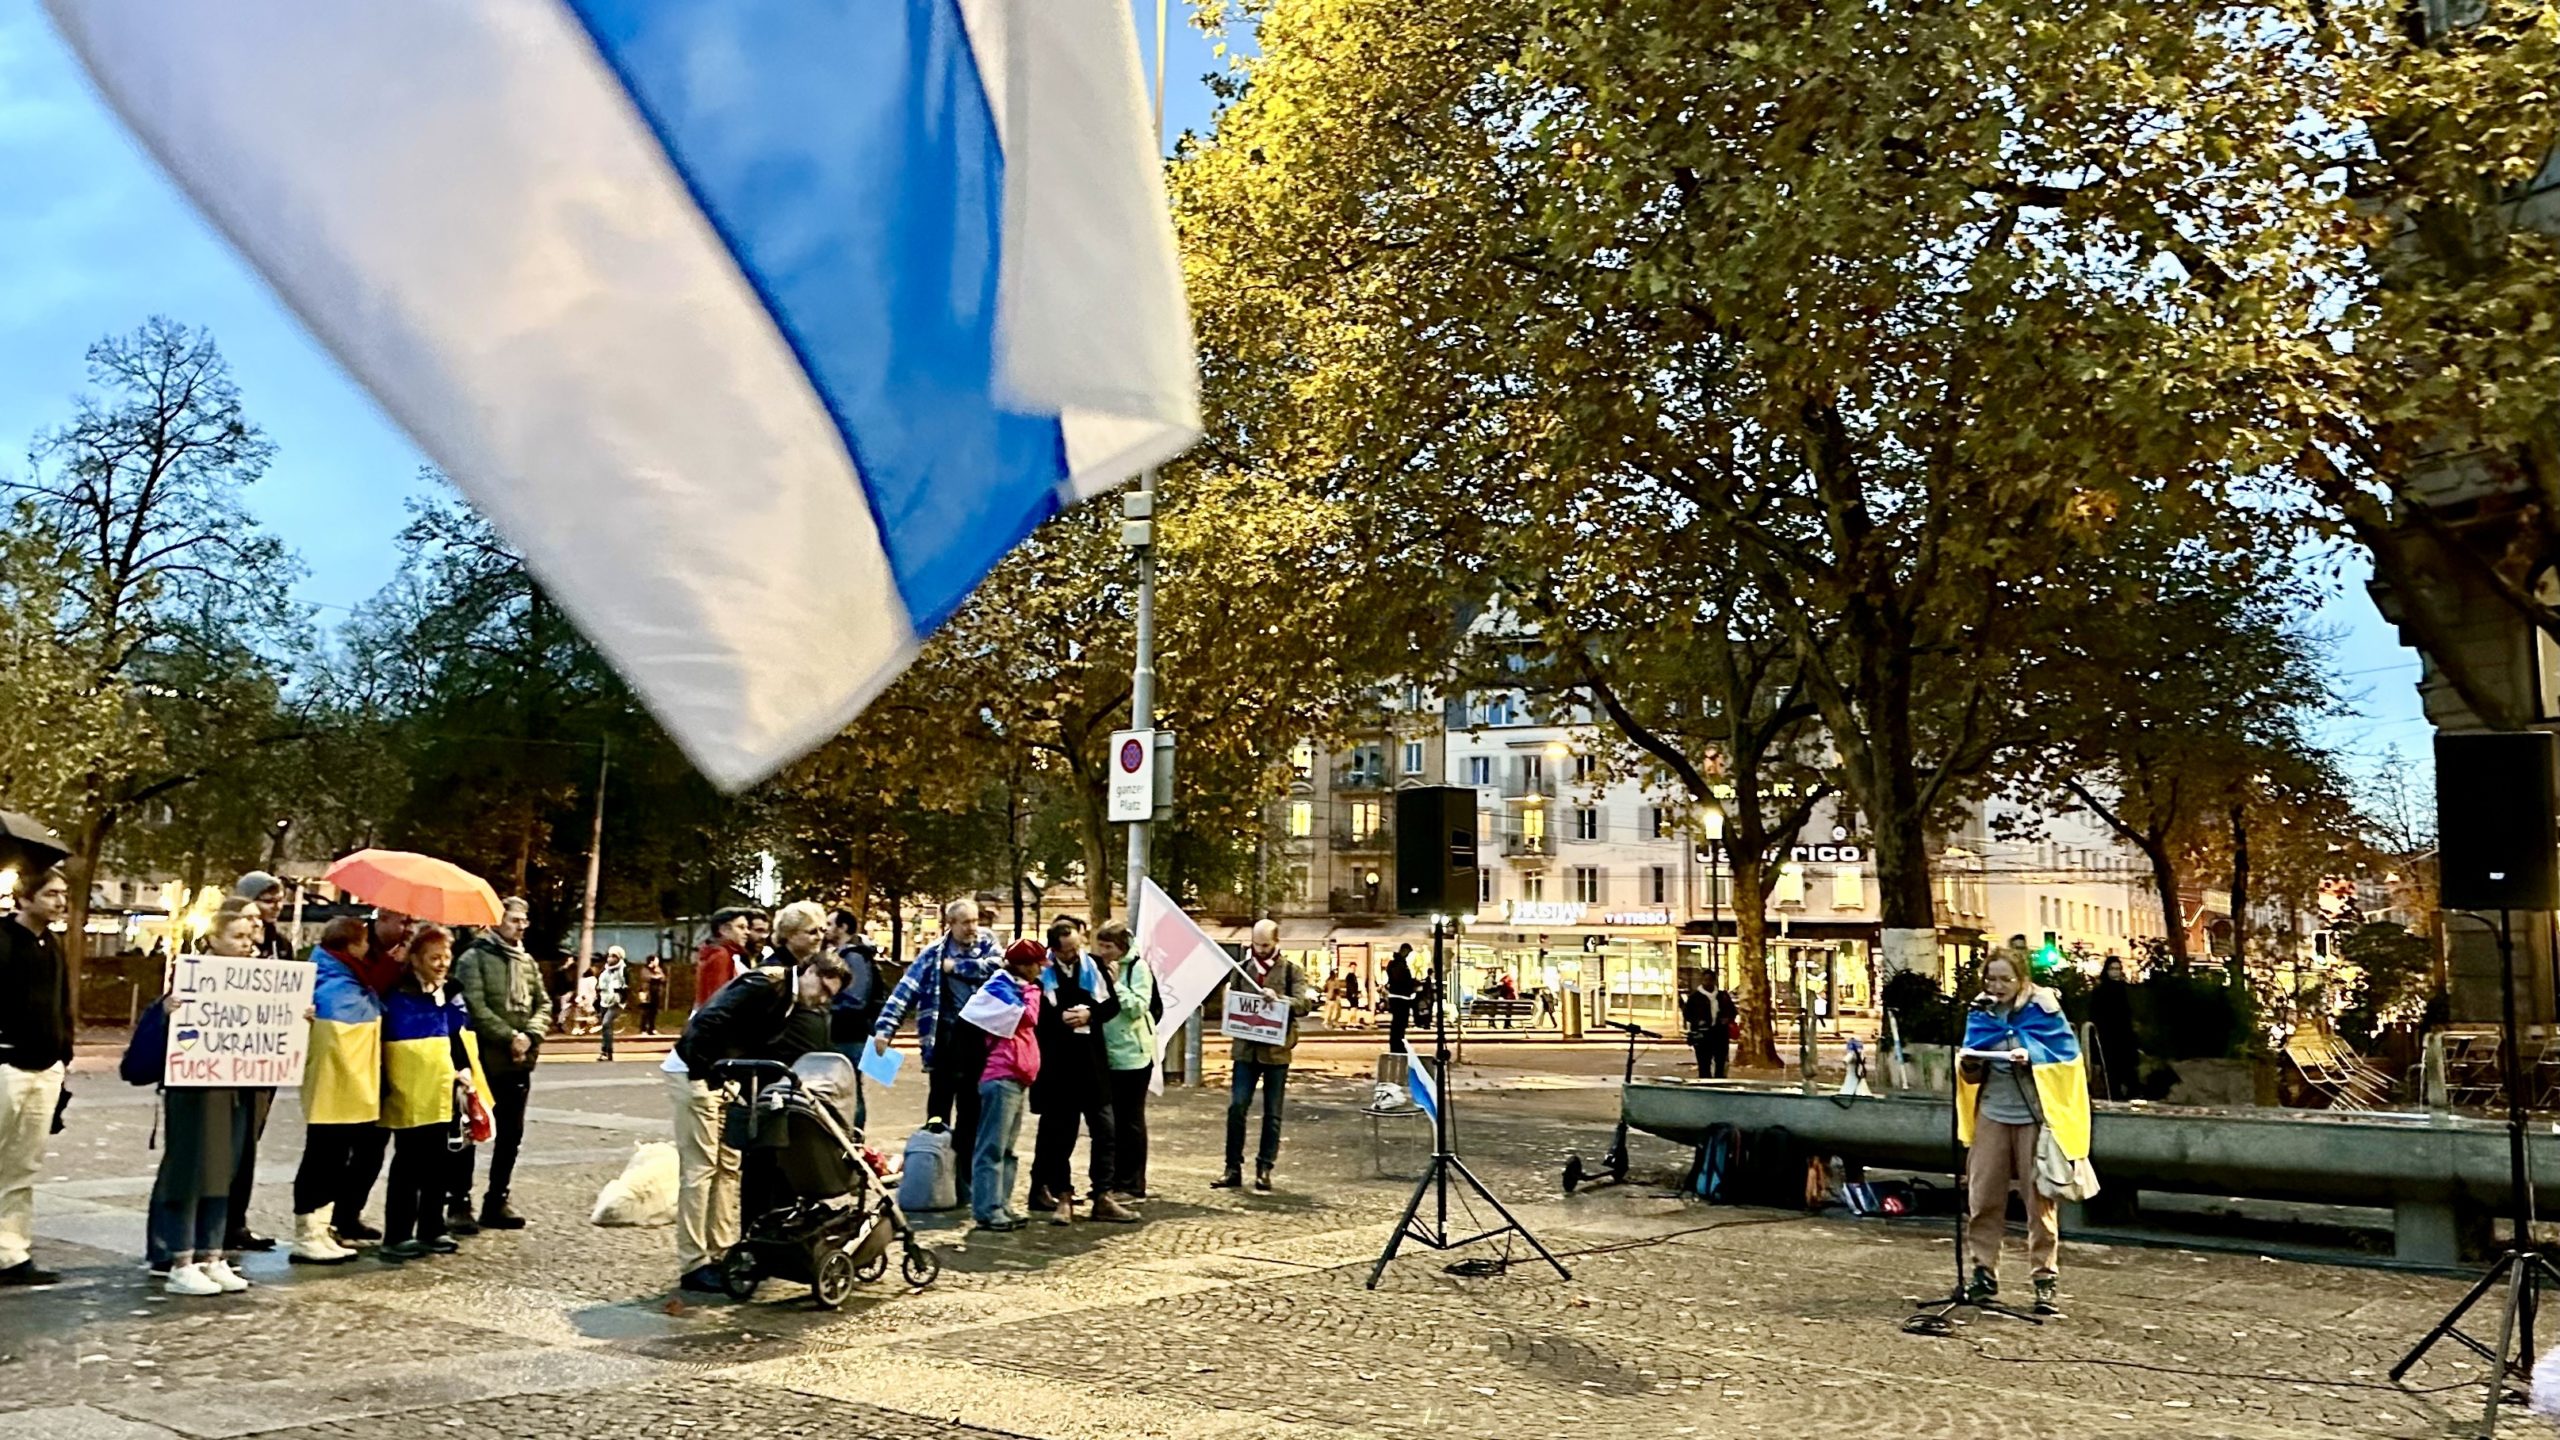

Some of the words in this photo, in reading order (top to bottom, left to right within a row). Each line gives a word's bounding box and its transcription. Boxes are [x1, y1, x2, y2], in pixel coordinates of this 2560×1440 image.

[224, 966, 304, 994] RUSSIAN
[176, 999, 197, 1027] I
[204, 1030, 288, 1055] UKRAINE
